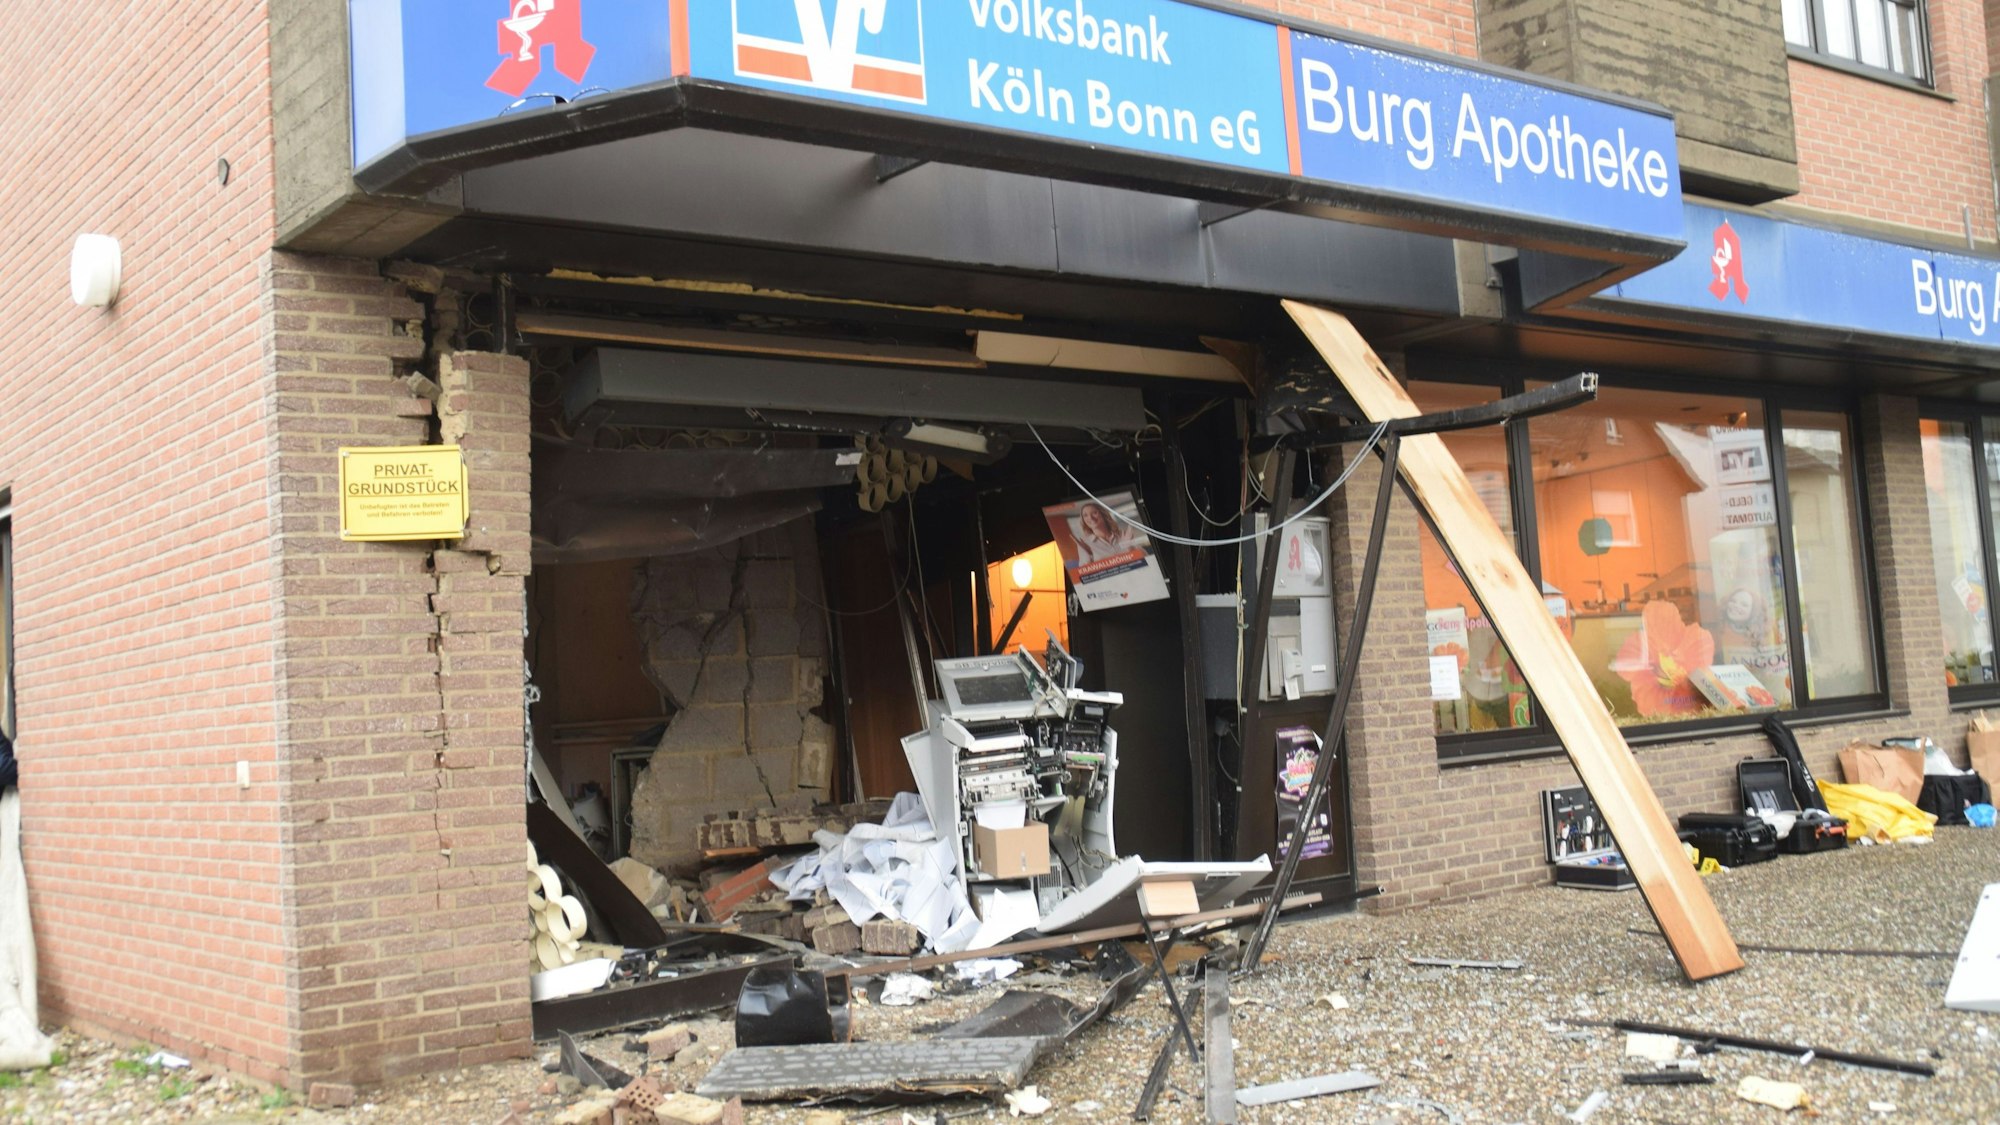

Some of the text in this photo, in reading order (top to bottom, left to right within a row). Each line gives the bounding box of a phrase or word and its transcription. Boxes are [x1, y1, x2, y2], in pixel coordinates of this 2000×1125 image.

[969, 0, 1172, 65] Volksbank
[968, 58, 1261, 155] Köln Bonn eG
[1302, 58, 1669, 198] Burg Apotheke
[1912, 259, 1986, 336] Burg
[348, 479, 459, 495] GRUNDSTÜCK
[374, 463, 433, 477] PRIVAT-
[360, 503, 397, 511] Unbefugten
